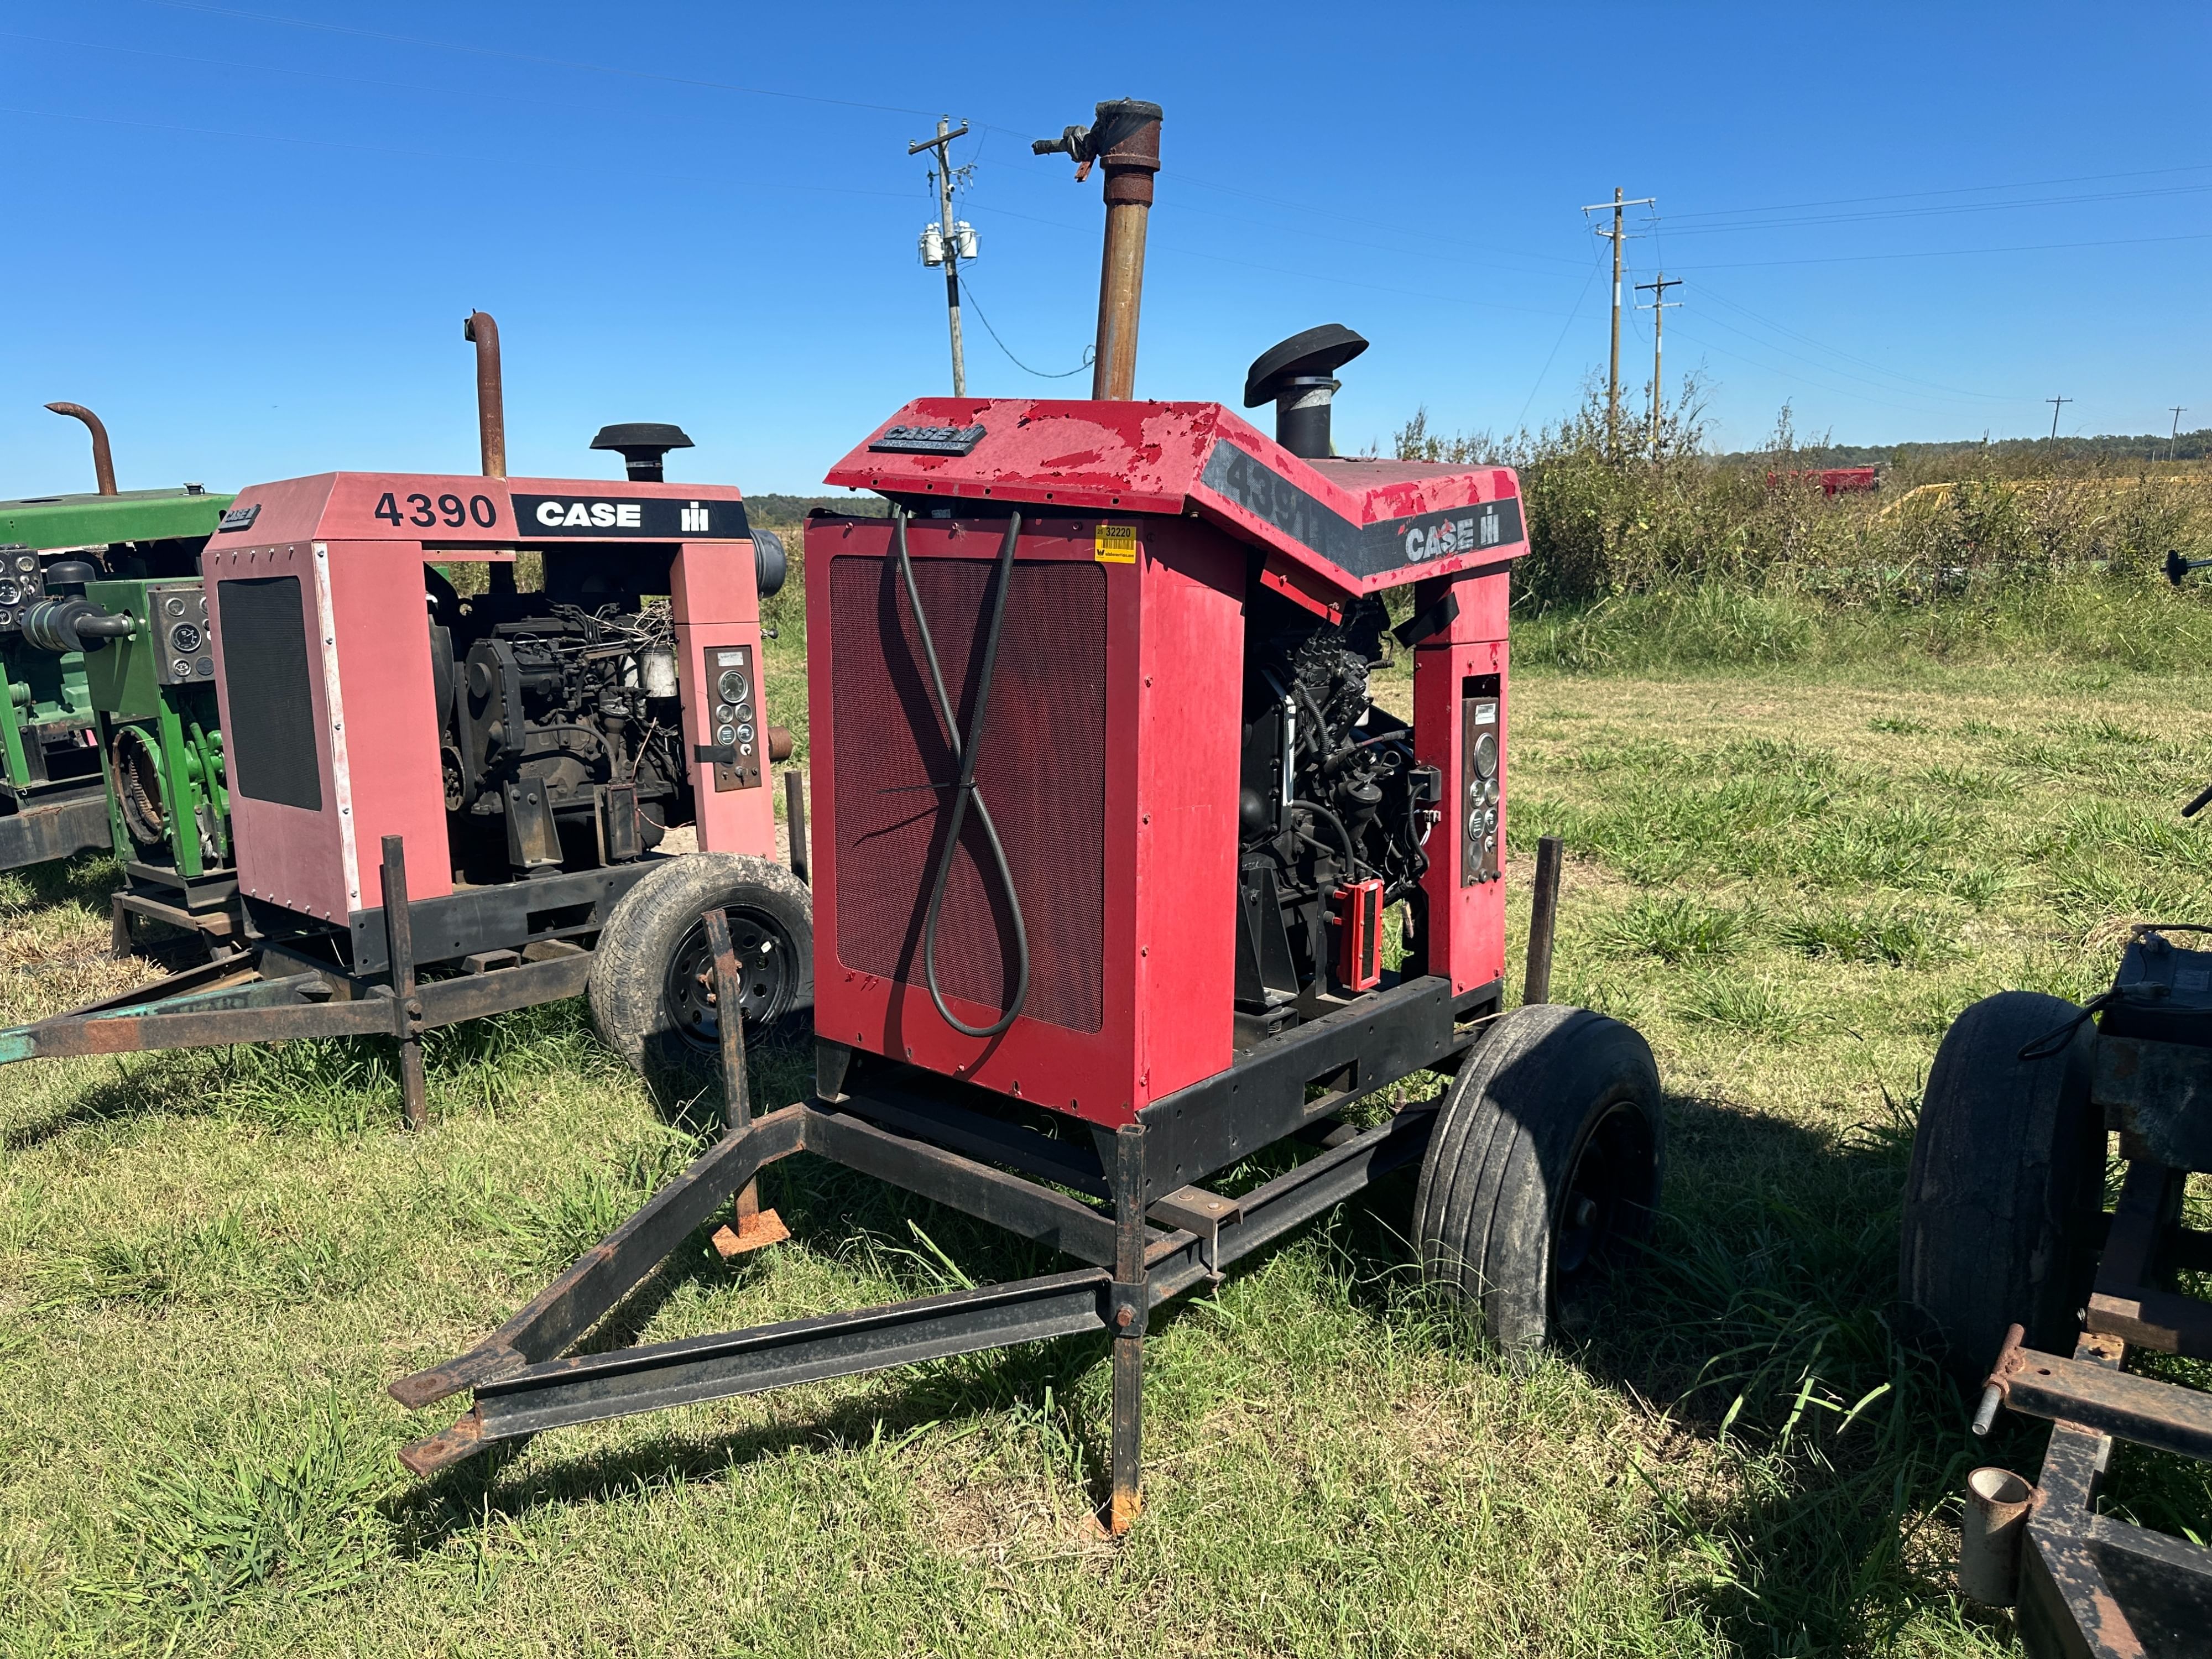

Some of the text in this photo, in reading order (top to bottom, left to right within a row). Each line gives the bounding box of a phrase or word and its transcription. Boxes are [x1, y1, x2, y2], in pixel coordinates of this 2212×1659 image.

[885, 425, 959, 441] CASE
[374, 493, 496, 528] 4390
[1227, 453, 1311, 545] 4391
[536, 502, 641, 527] CASE
[1106, 527, 1131, 537] 32220
[1405, 518, 1473, 562] CASE
